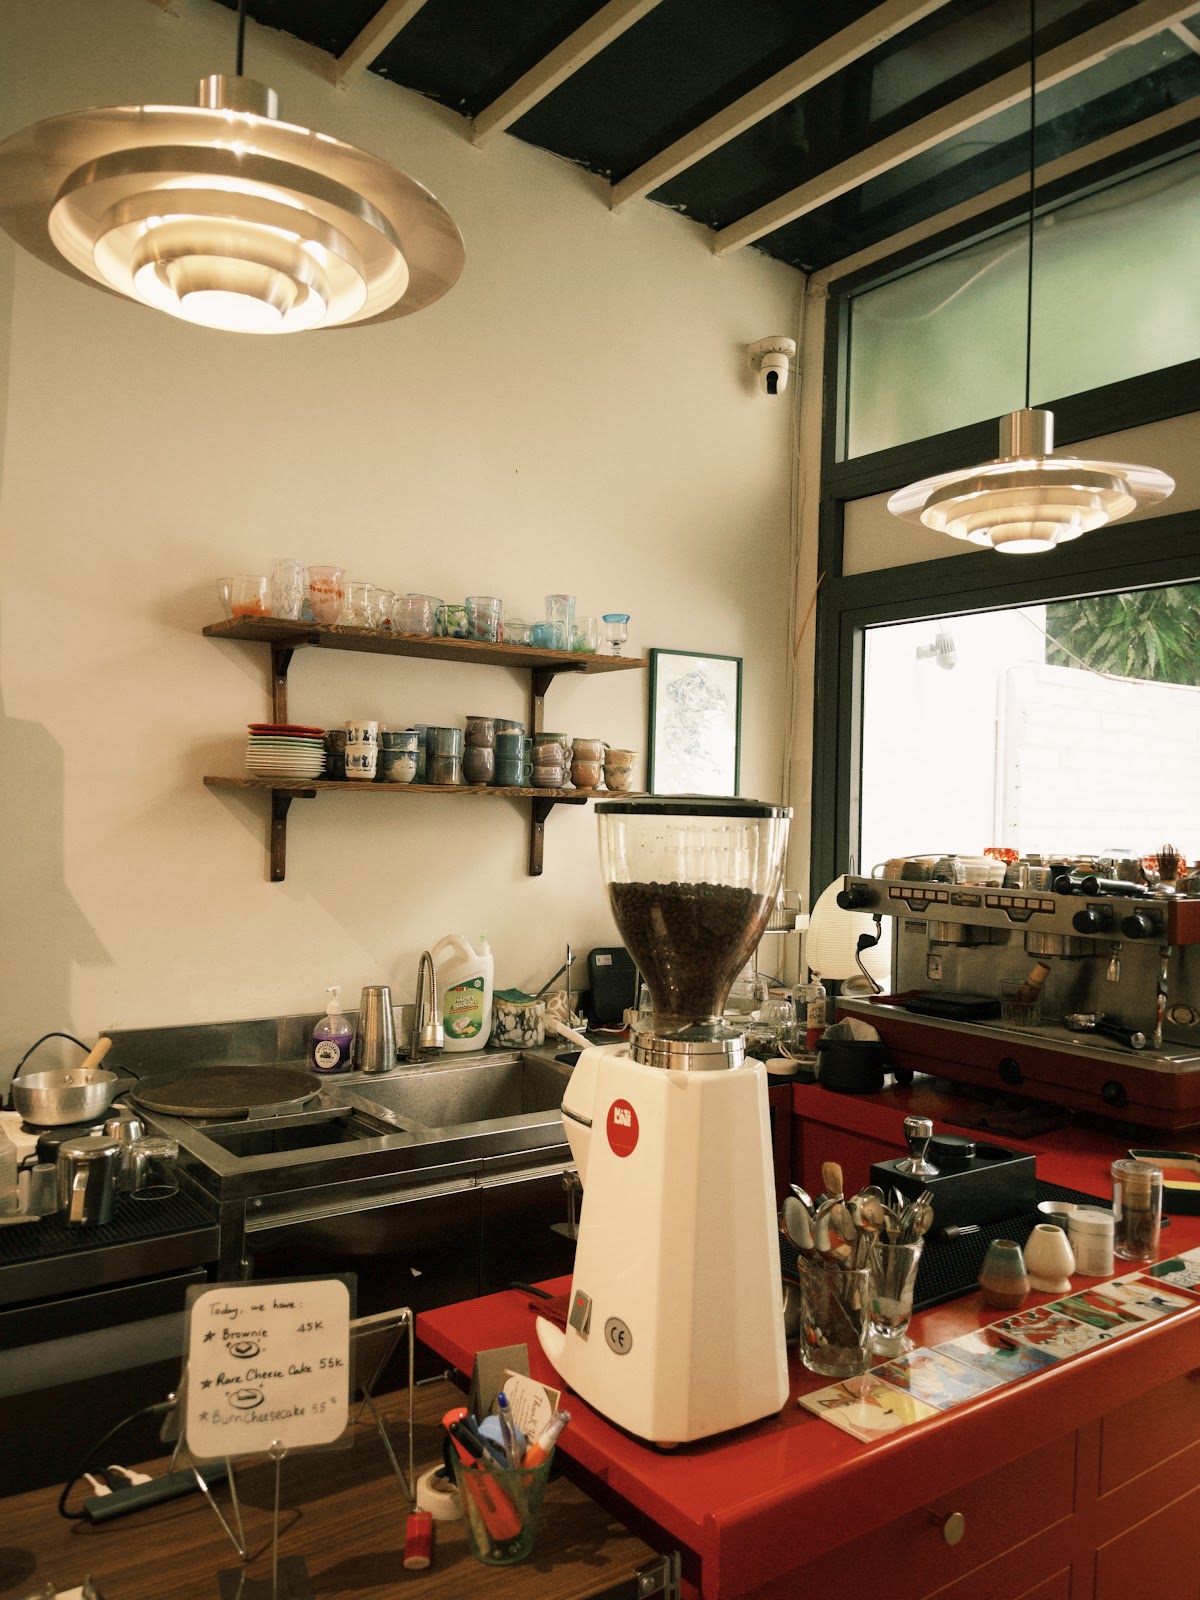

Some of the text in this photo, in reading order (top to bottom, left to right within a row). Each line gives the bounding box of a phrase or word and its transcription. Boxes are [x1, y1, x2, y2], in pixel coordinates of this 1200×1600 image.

[251, 1303, 265, 1312] we
[222, 1321, 324, 1341] Brownie 45K
[216, 1372, 243, 1387] Rare
[246, 1368, 284, 1381] Cheese
[288, 1362, 313, 1376] Cake
